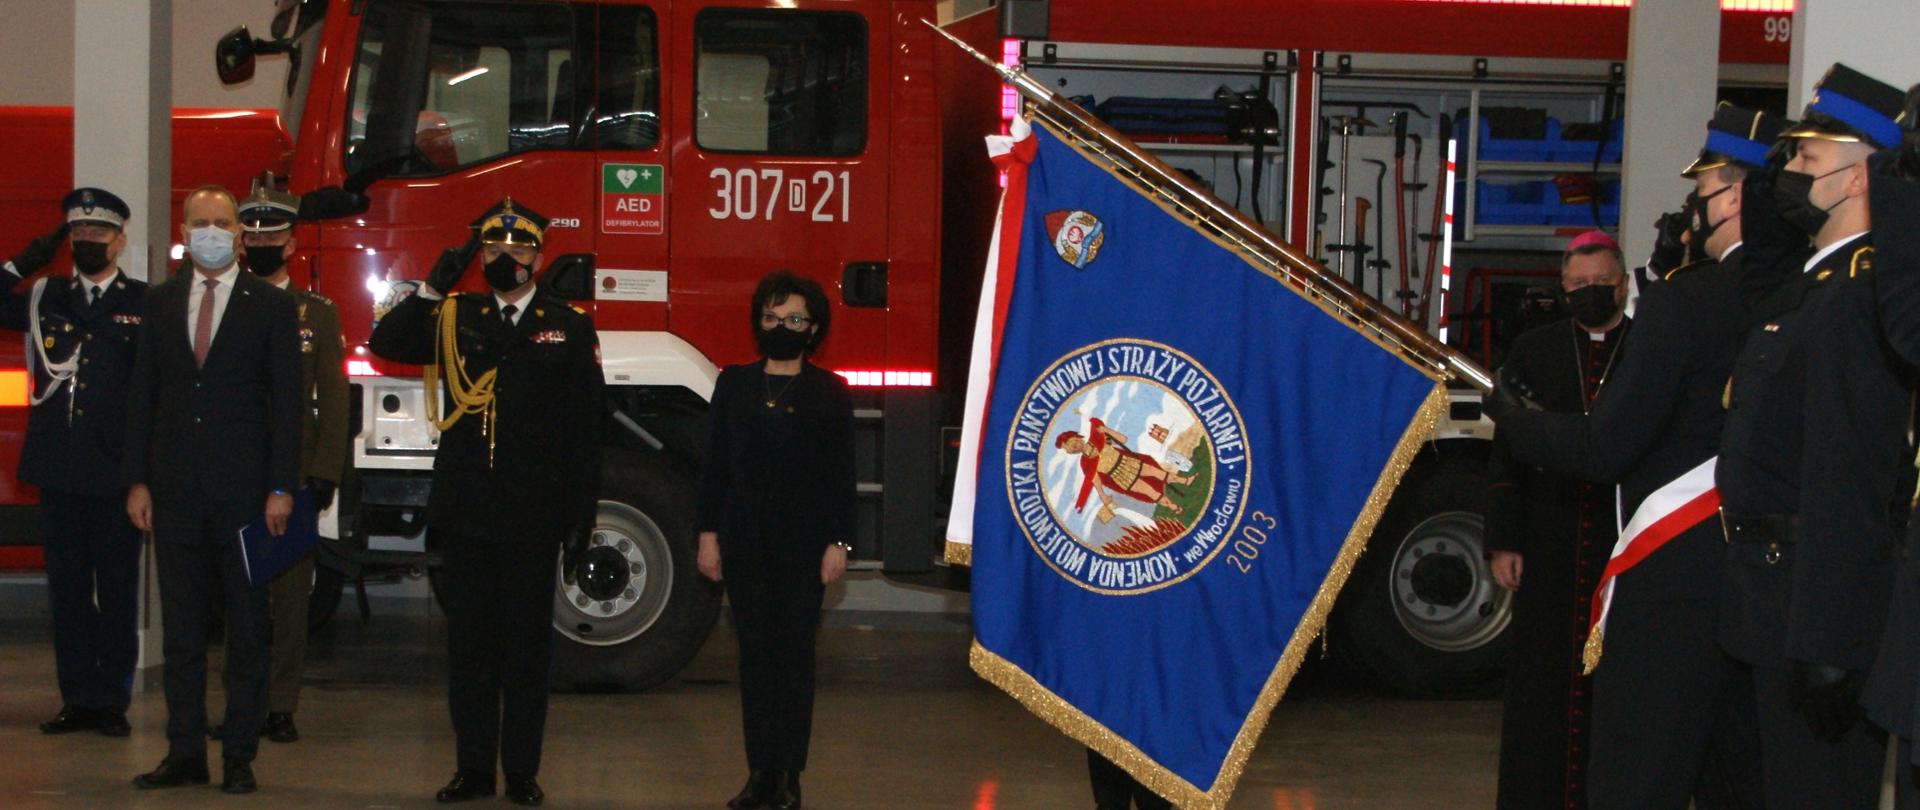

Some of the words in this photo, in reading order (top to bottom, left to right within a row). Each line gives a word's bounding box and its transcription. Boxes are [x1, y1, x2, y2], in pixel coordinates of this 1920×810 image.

[551, 218, 580, 228] 290
[606, 219, 660, 228] DEFIBRYLATOR
[615, 198, 651, 212] AED
[1108, 346, 1186, 383] STRAŻY
[1014, 350, 1104, 453] PAŃSTWOWEJ
[1183, 544, 1203, 563] we
[1193, 478, 1241, 549] Wrocławiu
[1226, 511, 1276, 573] 2003
[1089, 551, 1178, 588] KOMENDA
